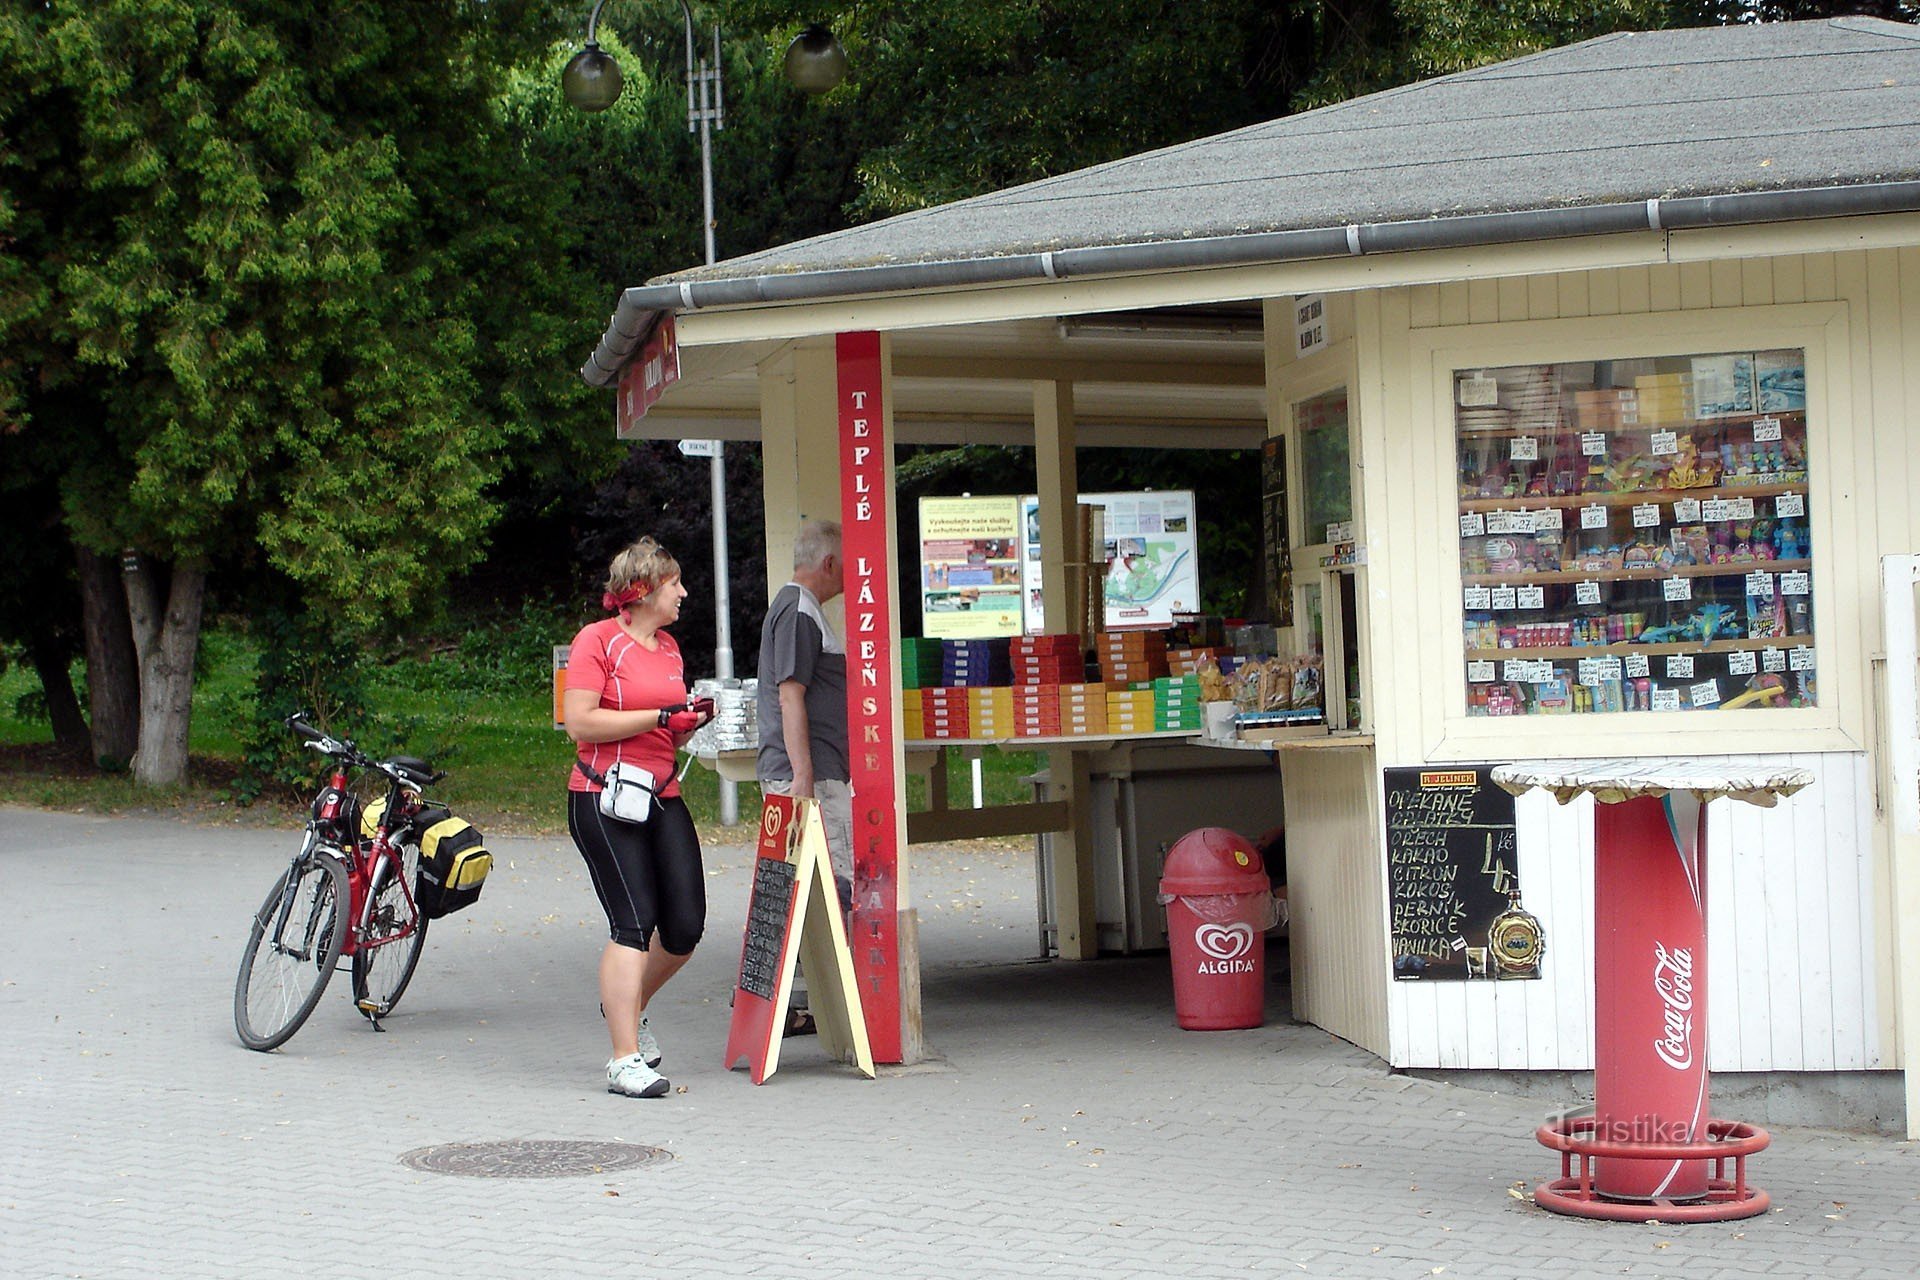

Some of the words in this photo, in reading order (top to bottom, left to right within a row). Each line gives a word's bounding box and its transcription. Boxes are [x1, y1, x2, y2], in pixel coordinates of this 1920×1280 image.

[851, 391, 873, 522] TEPLÉ
[1391, 848, 1449, 864] KAKAO
[1394, 865, 1458, 882] CITRON
[1393, 937, 1451, 961] VANILKA
[1198, 960, 1254, 974] ALGIDA
[1655, 941, 1693, 1070] Coca-Cola
